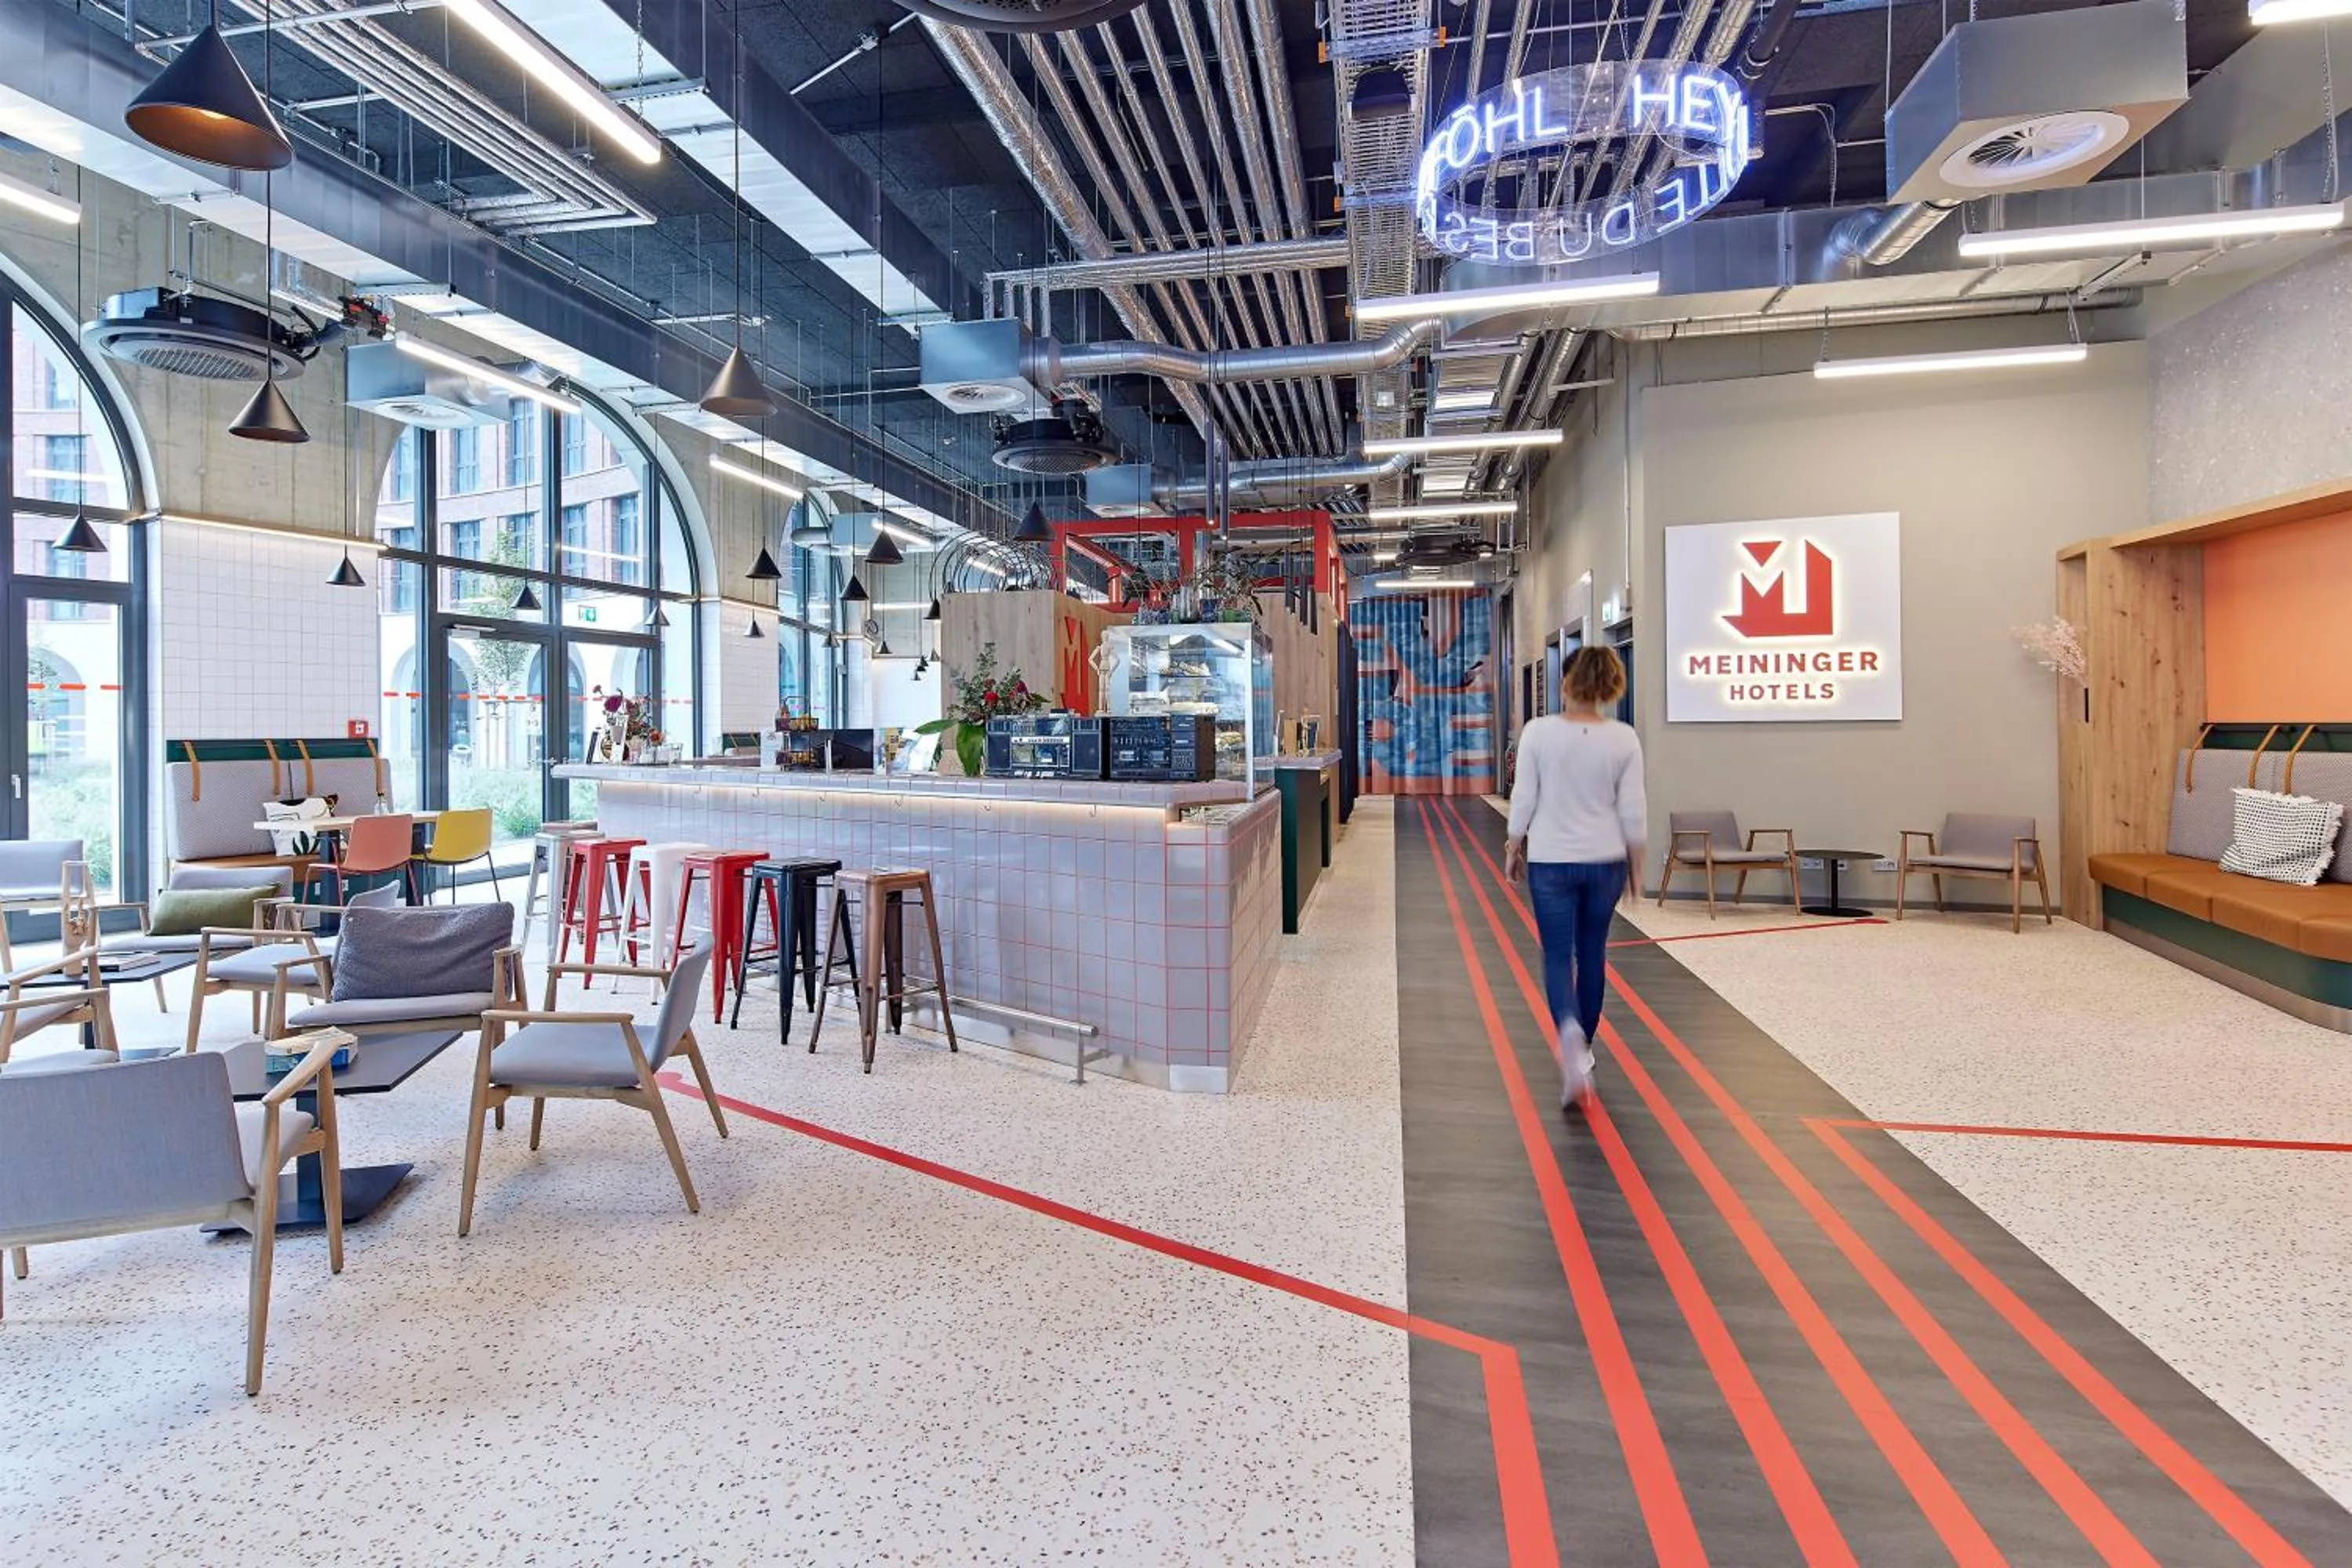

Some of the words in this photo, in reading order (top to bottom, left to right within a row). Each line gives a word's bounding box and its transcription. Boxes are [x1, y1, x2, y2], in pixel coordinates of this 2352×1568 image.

[1633, 74, 1741, 141] HEY
[1689, 652, 1878, 675] MEININGER
[1730, 683, 1835, 700] HOTELS
